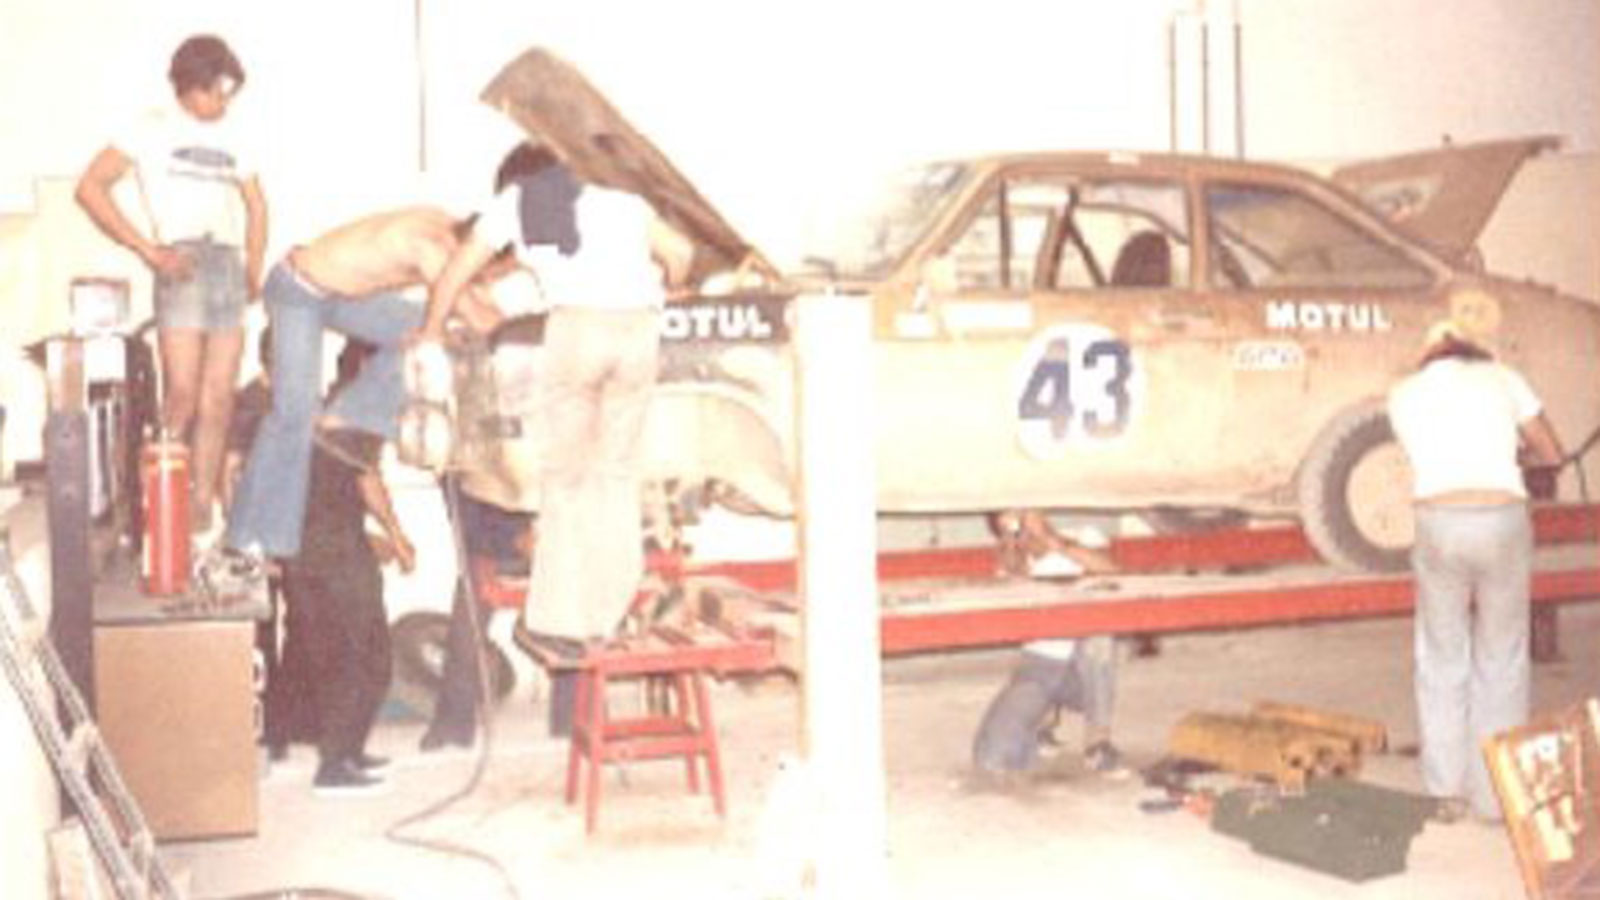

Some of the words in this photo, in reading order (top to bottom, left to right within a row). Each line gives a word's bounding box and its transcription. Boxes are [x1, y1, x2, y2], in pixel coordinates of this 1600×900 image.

[661, 303, 772, 339] OTUL
[1266, 302, 1390, 329] MOTUL
[1018, 337, 1132, 440] 43
